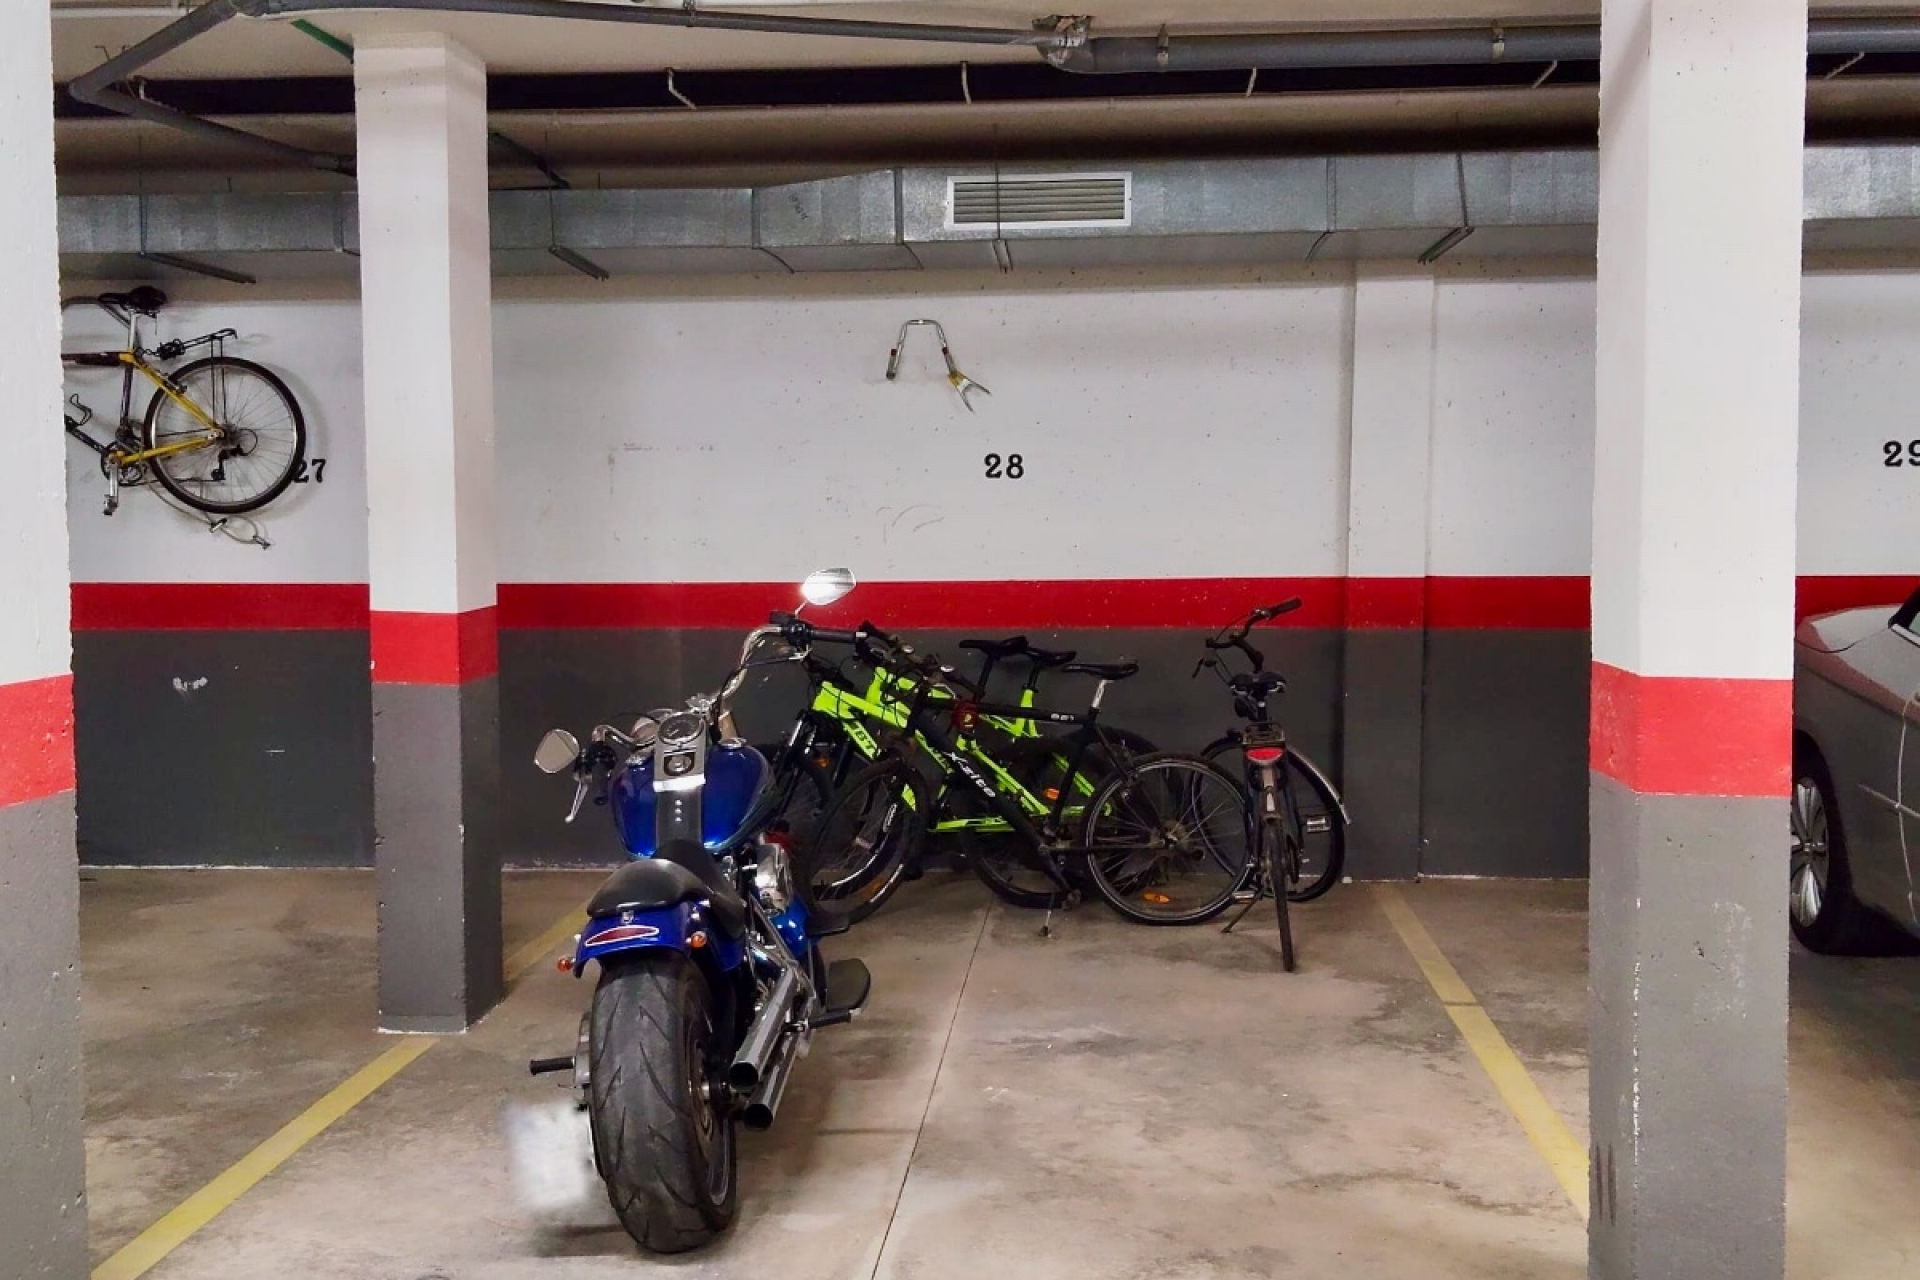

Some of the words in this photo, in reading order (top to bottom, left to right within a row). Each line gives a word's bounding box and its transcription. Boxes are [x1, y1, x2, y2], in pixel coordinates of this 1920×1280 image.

[984, 453, 1024, 479] 28
[1883, 440, 1920, 467] 29
[291, 458, 327, 483] 27
